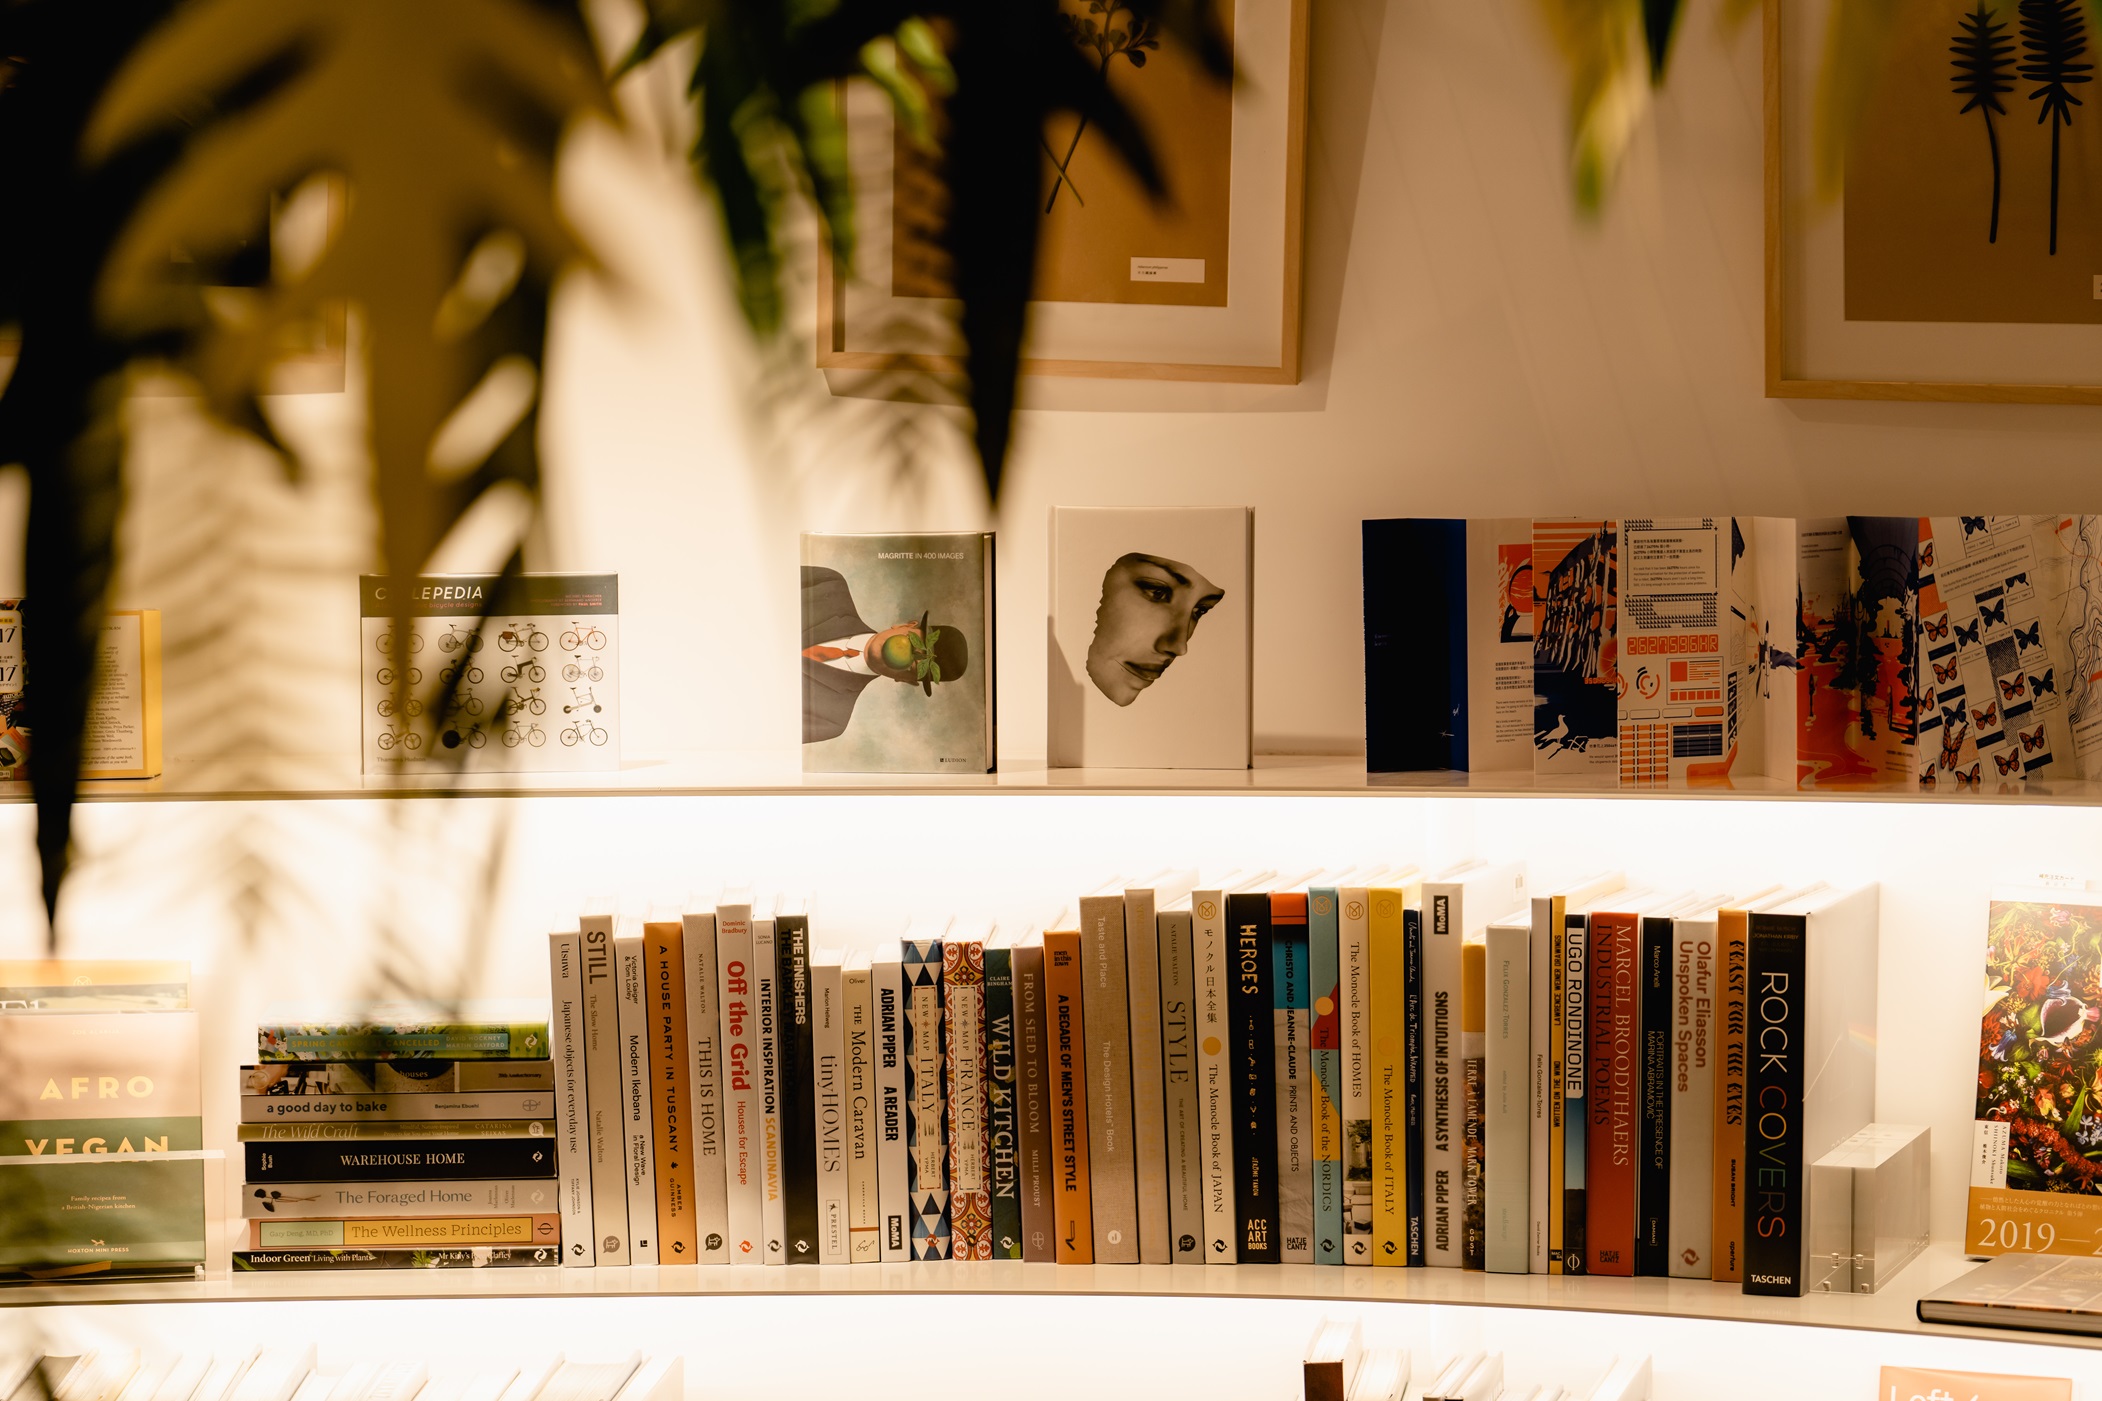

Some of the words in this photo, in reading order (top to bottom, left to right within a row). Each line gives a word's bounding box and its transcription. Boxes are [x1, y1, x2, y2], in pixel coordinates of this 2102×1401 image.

[878, 552, 914, 560] MAGRITTE
[923, 552, 936, 560] 400
[938, 552, 964, 560] IMAGES
[375, 586, 483, 600] CLEPEDIA
[659, 945, 667, 954] A
[793, 928, 804, 955] THE
[1097, 917, 1105, 941] Taste
[587, 931, 607, 984] STILL
[1098, 944, 1106, 960] and
[1239, 924, 1258, 995] HEROES
[1569, 933, 1582, 973] UGO
[1615, 925, 1631, 1007] MARCEL
[1696, 941, 1711, 994] Olafur
[1729, 940, 1745, 995] FEAST
[660, 961, 671, 1010] HOUSE
[730, 961, 748, 995] Off
[793, 957, 806, 1025] FINISHERS
[1099, 963, 1108, 988] Place
[1595, 925, 1611, 1050] INDUSTRIAL
[1676, 941, 1693, 1025] Unspoken
[590, 1010, 598, 1027] Slow
[732, 1001, 750, 1036] the
[760, 979, 772, 1034] INTERIOR
[853, 1005, 861, 1025] THE
[881, 988, 895, 1032] ADRIAN
[1058, 995, 1069, 1003] A
[1728, 1000, 1743, 1035] FOR
[663, 1017, 673, 1060] PARTY
[1058, 1006, 1070, 1054] DECADE
[1166, 1001, 1188, 1084] STYLE
[1435, 992, 1449, 1058] INTUITIONS
[1568, 979, 1582, 1090] RONDINONE
[1696, 998, 1710, 1068] Eliasson
[1760, 972, 1789, 1073] ROCK
[292, 1040, 326, 1048] SPRING
[629, 1035, 640, 1076] Modern
[698, 1037, 713, 1078] THIS
[851, 1030, 867, 1091] Modern
[883, 1035, 896, 1068] PIPER
[992, 1014, 1011, 1081] WILD
[1061, 1056, 1071, 1068] OF
[1675, 1030, 1692, 1092] Spaces
[1728, 1041, 1743, 1077] THE
[666, 1067, 674, 1080] IN
[732, 1043, 754, 1090] Grid
[762, 1038, 775, 1114] INSPIRATION
[920, 1058, 935, 1114] ITALY
[1209, 1064, 1218, 1085] The
[1435, 1061, 1449, 1075] OF
[40, 1076, 154, 1100] AFRO
[278, 1102, 310, 1115] good
[314, 1102, 337, 1114] day
[340, 1102, 352, 1112] to
[356, 1101, 388, 1112] bake
[632, 1080, 641, 1121] Ikebana
[700, 1084, 713, 1097] IS
[960, 1058, 975, 1131] FRANCE
[1062, 1071, 1073, 1107] MEN'S
[1209, 1087, 1219, 1130] Monocle
[1595, 1057, 1610, 1125] POEMS
[1613, 1014, 1630, 1166] BROODTHAERS
[1727, 1083, 1742, 1125] EYES
[667, 1087, 678, 1153] TUSCANY
[702, 1103, 716, 1156] HOME
[818, 1056, 840, 1172] tinyHOMES
[853, 1096, 867, 1160] Caravan
[884, 1099, 898, 1141] READER
[1436, 1077, 1448, 1142] SYNTHESIS
[262, 1124, 286, 1138] The
[291, 1122, 324, 1140] Wild
[324, 1122, 358, 1138] Craft
[993, 1089, 1014, 1199] KITCHEN
[1063, 1109, 1075, 1152] STREET
[1211, 1134, 1221, 1159] Book
[1436, 1144, 1449, 1152] A
[340, 1154, 421, 1166] WAREHOUSE
[426, 1152, 465, 1164] HOME
[766, 1117, 778, 1201] SCANDINAVIA
[1065, 1156, 1076, 1192] STYLE
[1213, 1161, 1221, 1171] of
[1758, 1086, 1787, 1237] COVERS
[336, 1191, 363, 1204] The
[368, 1190, 426, 1206] Foraged
[430, 1190, 472, 1202] Home
[1212, 1175, 1223, 1213] JAPAN
[352, 1226, 378, 1238] The
[382, 1224, 447, 1237] Wellness
[451, 1224, 522, 1238] Principles
[1248, 1219, 1267, 1230] ACC
[1248, 1231, 1267, 1242] ART
[250, 1254, 282, 1262] Indoor
[283, 1254, 311, 1262] Green
[313, 1254, 334, 1264] Living
[336, 1254, 350, 1262] with
[352, 1254, 372, 1262] Plants
[1751, 1274, 1791, 1285] TASCHEN
